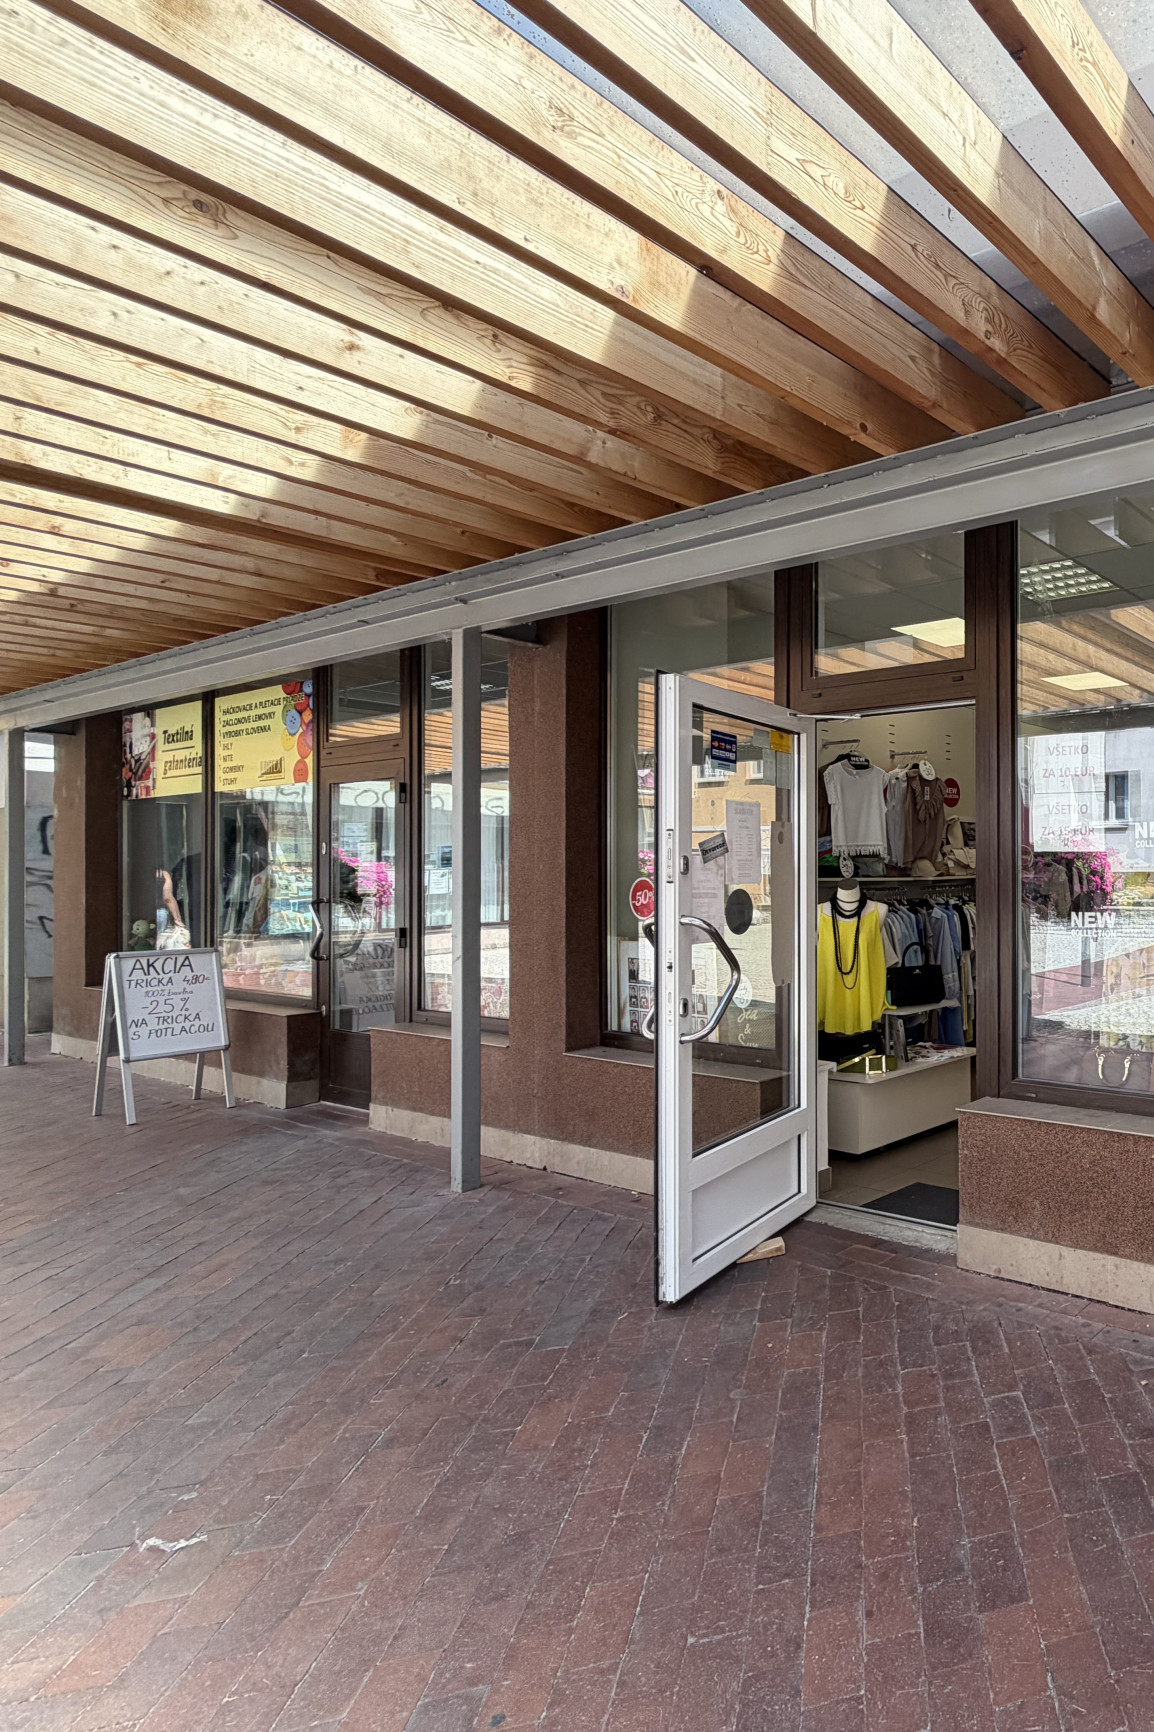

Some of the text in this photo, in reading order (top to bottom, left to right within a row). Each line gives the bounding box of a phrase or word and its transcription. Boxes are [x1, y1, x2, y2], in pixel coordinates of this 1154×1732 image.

[252, 711, 276, 722] LEMOVKY
[162, 724, 194, 745] Textilná
[245, 725, 271, 736] SLOVENKA
[1048, 744, 1089, 756] VŠETKO
[163, 752, 202, 776] galantéria
[1042, 766, 1096, 778] ZA 10 EUR
[1047, 802, 1089, 815] VŠETKO
[1042, 826, 1055, 836] ZA
[1070, 911, 1116, 928] NEW
[128, 955, 194, 977] AKCIA
[144, 990, 165, 998] 100%
[128, 1018, 148, 1029] NA
[131, 1030, 141, 1040] S
